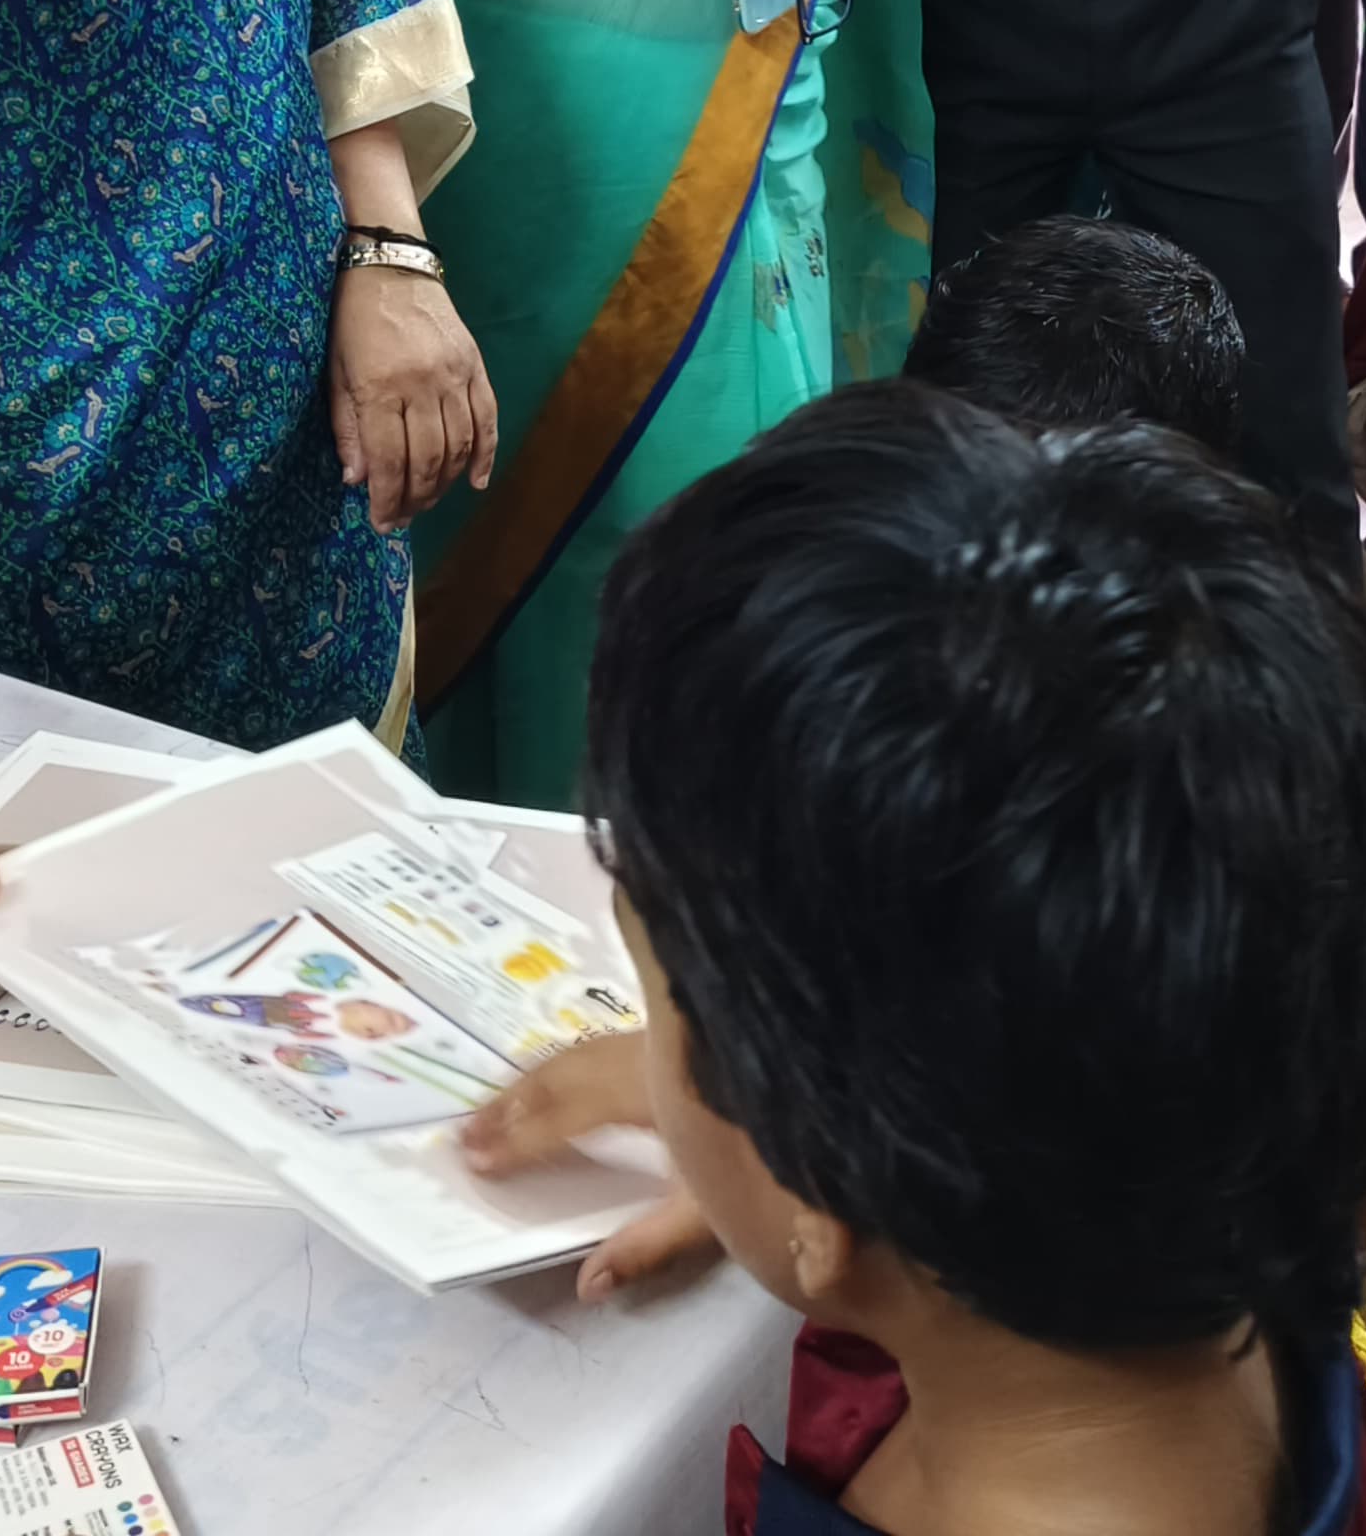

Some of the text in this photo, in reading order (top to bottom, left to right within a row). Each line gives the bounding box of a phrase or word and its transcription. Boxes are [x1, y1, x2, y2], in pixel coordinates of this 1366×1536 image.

[7, 1350, 31, 1365] 10
[107, 1424, 134, 1454] WAX
[85, 1430, 123, 1490] CRAYONS
